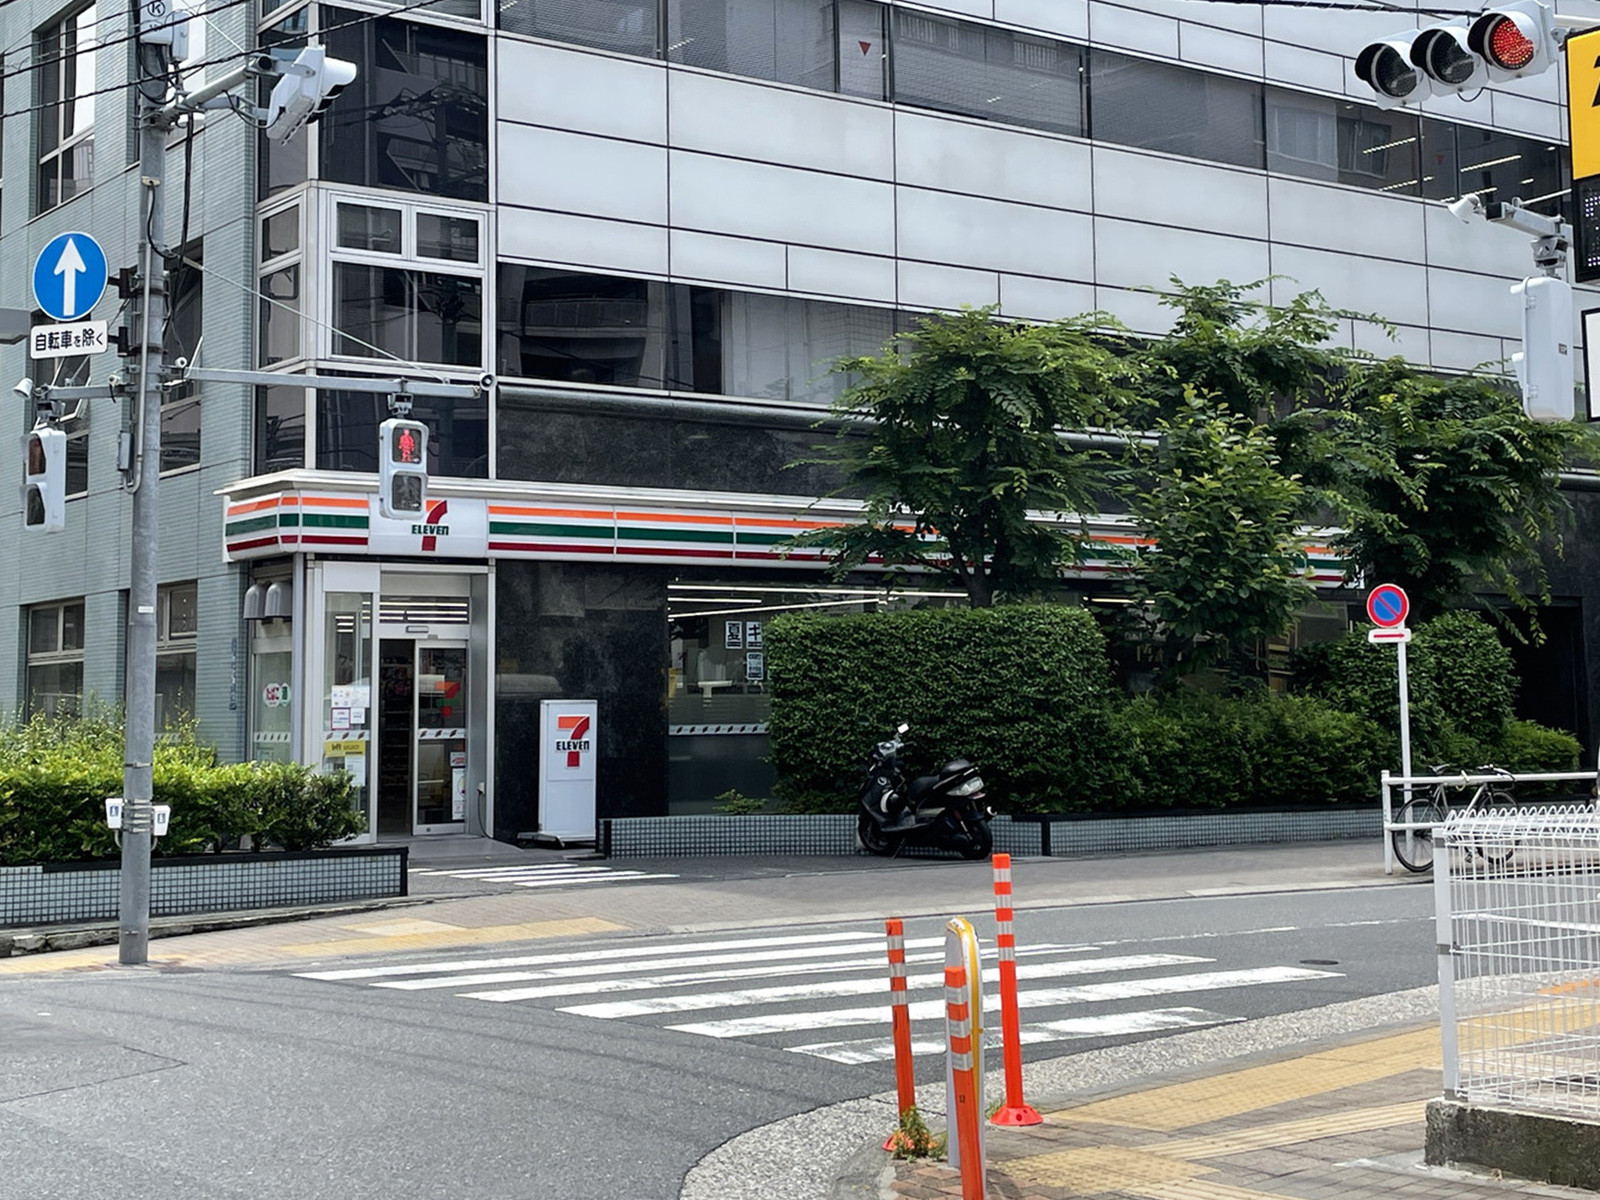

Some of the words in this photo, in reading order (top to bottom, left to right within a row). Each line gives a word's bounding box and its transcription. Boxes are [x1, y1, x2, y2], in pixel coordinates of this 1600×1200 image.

[35, 328, 103, 351] 自転車を除く
[422, 499, 448, 551] 7
[557, 715, 590, 767] 7
